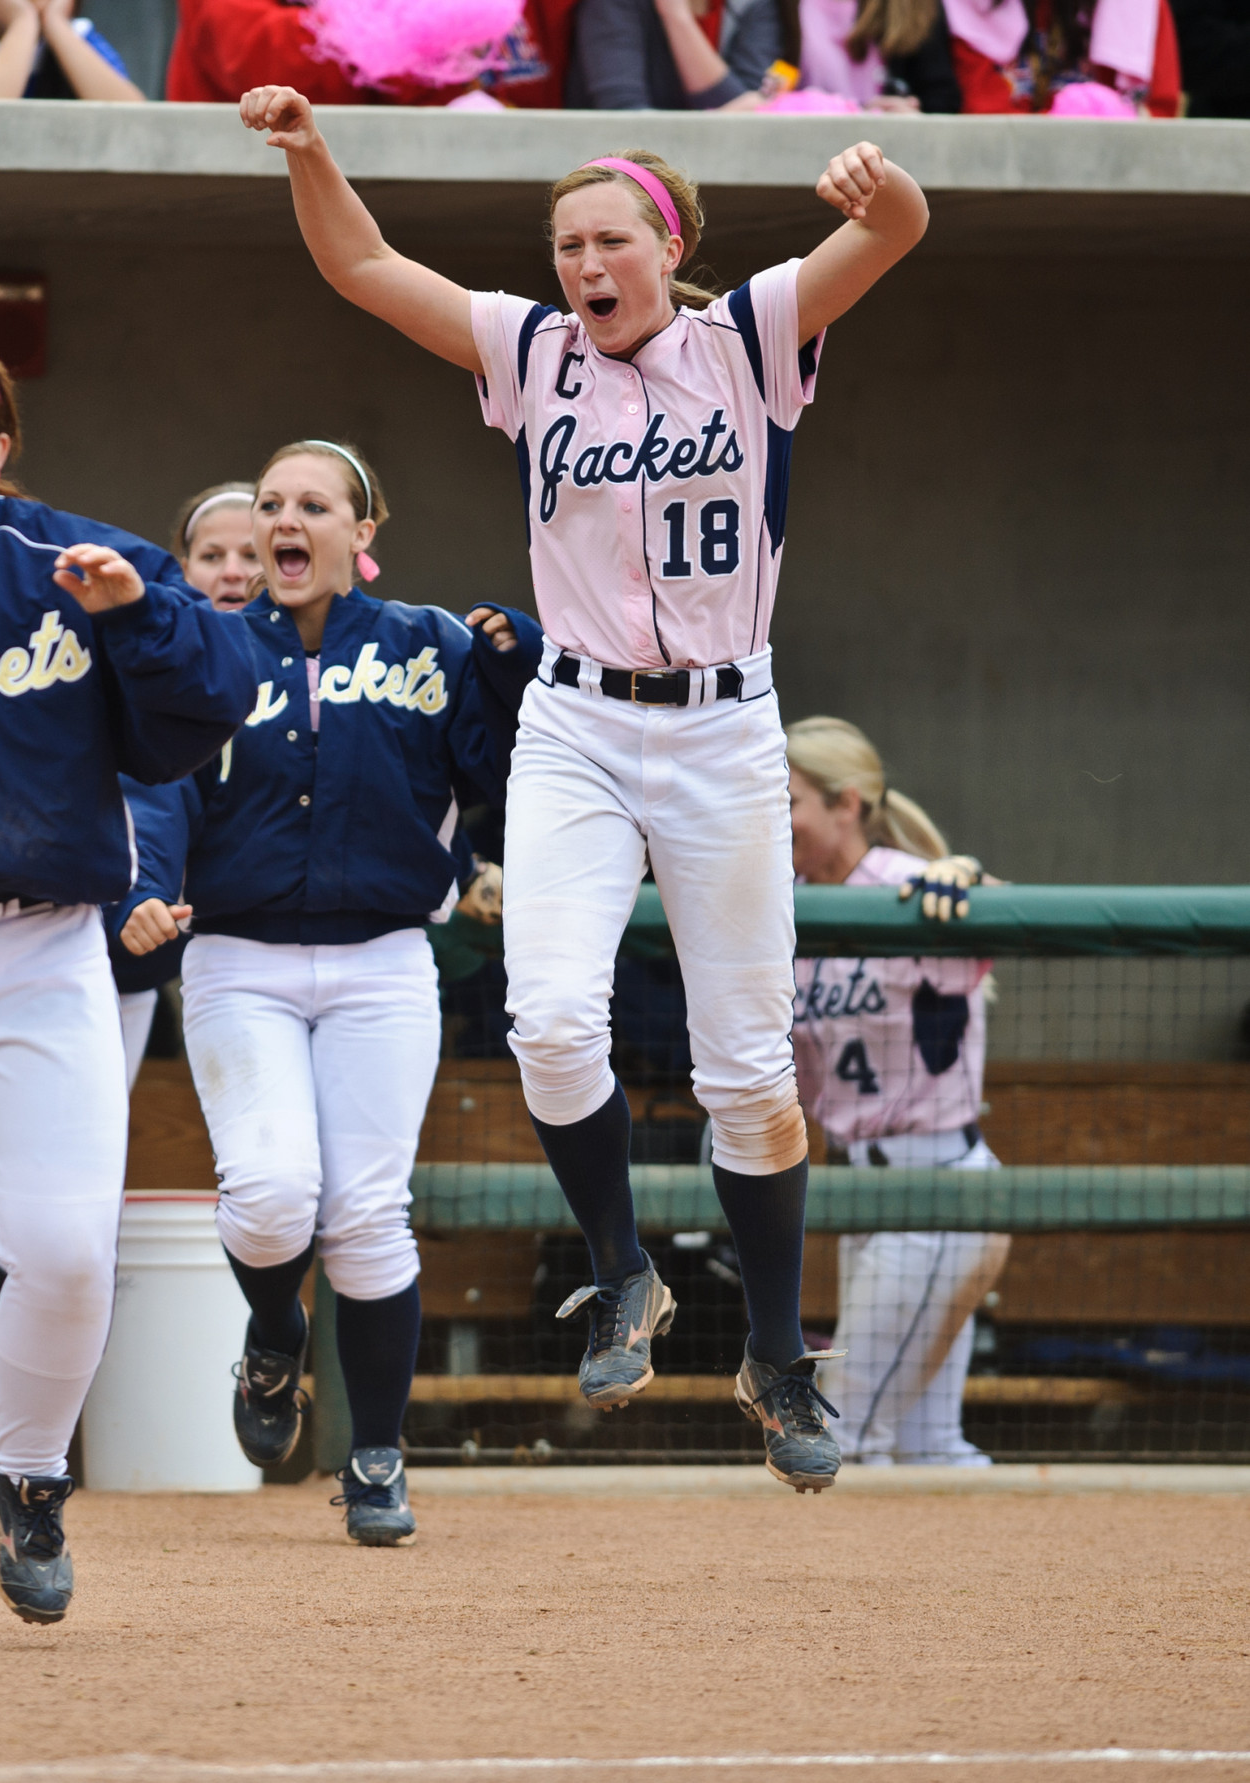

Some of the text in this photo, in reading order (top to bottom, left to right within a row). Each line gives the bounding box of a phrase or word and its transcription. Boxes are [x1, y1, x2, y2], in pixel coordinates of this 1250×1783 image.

[554, 351, 586, 401] C
[538, 407, 745, 524] Jackets
[659, 497, 741, 581] 18
[220, 641, 449, 783] ckets
[794, 957, 887, 1022] kets
[834, 1036, 880, 1096] 4
